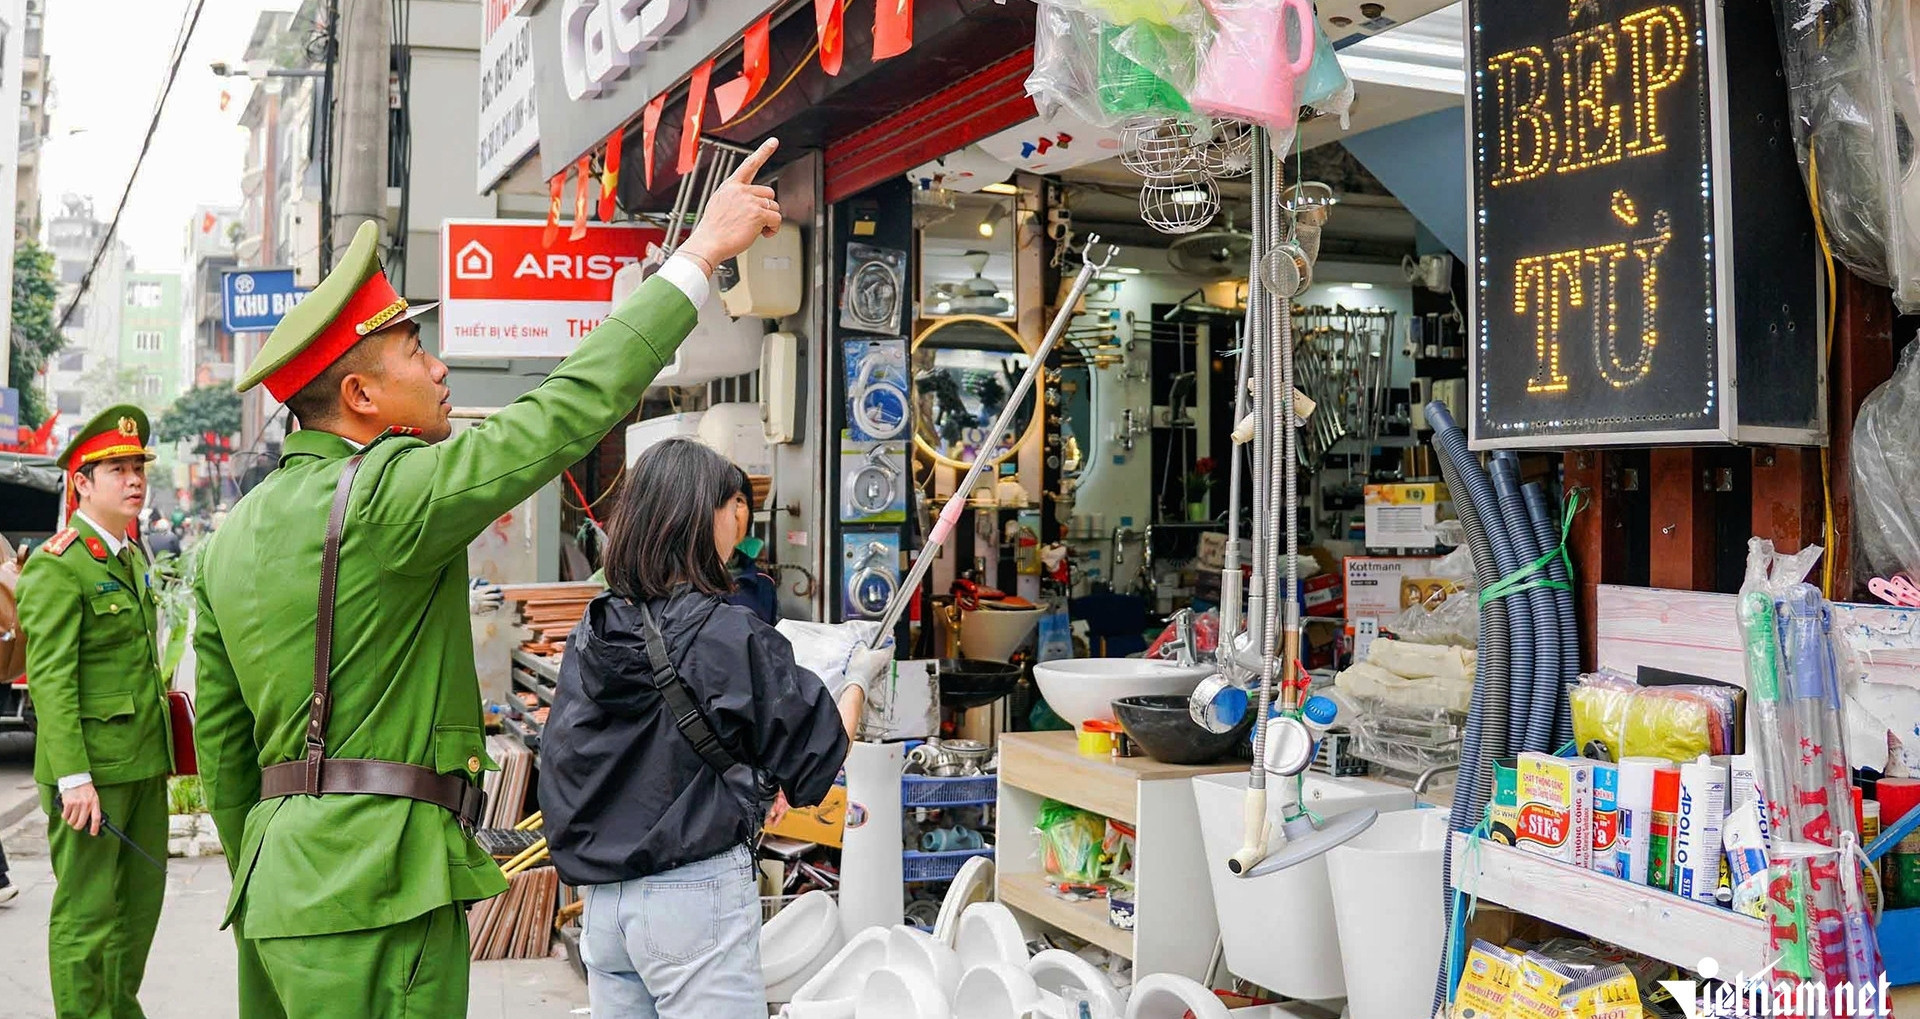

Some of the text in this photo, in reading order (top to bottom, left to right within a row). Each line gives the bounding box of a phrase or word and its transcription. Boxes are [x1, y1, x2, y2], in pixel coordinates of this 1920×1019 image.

[234, 293, 268, 317] KHU
[454, 323, 548, 340] THIẾT BỊ VỆ SINH
[1349, 561, 1401, 572] Kottmann
[1528, 813, 1560, 842] SiFa
[1678, 780, 1692, 864] APOLLO
